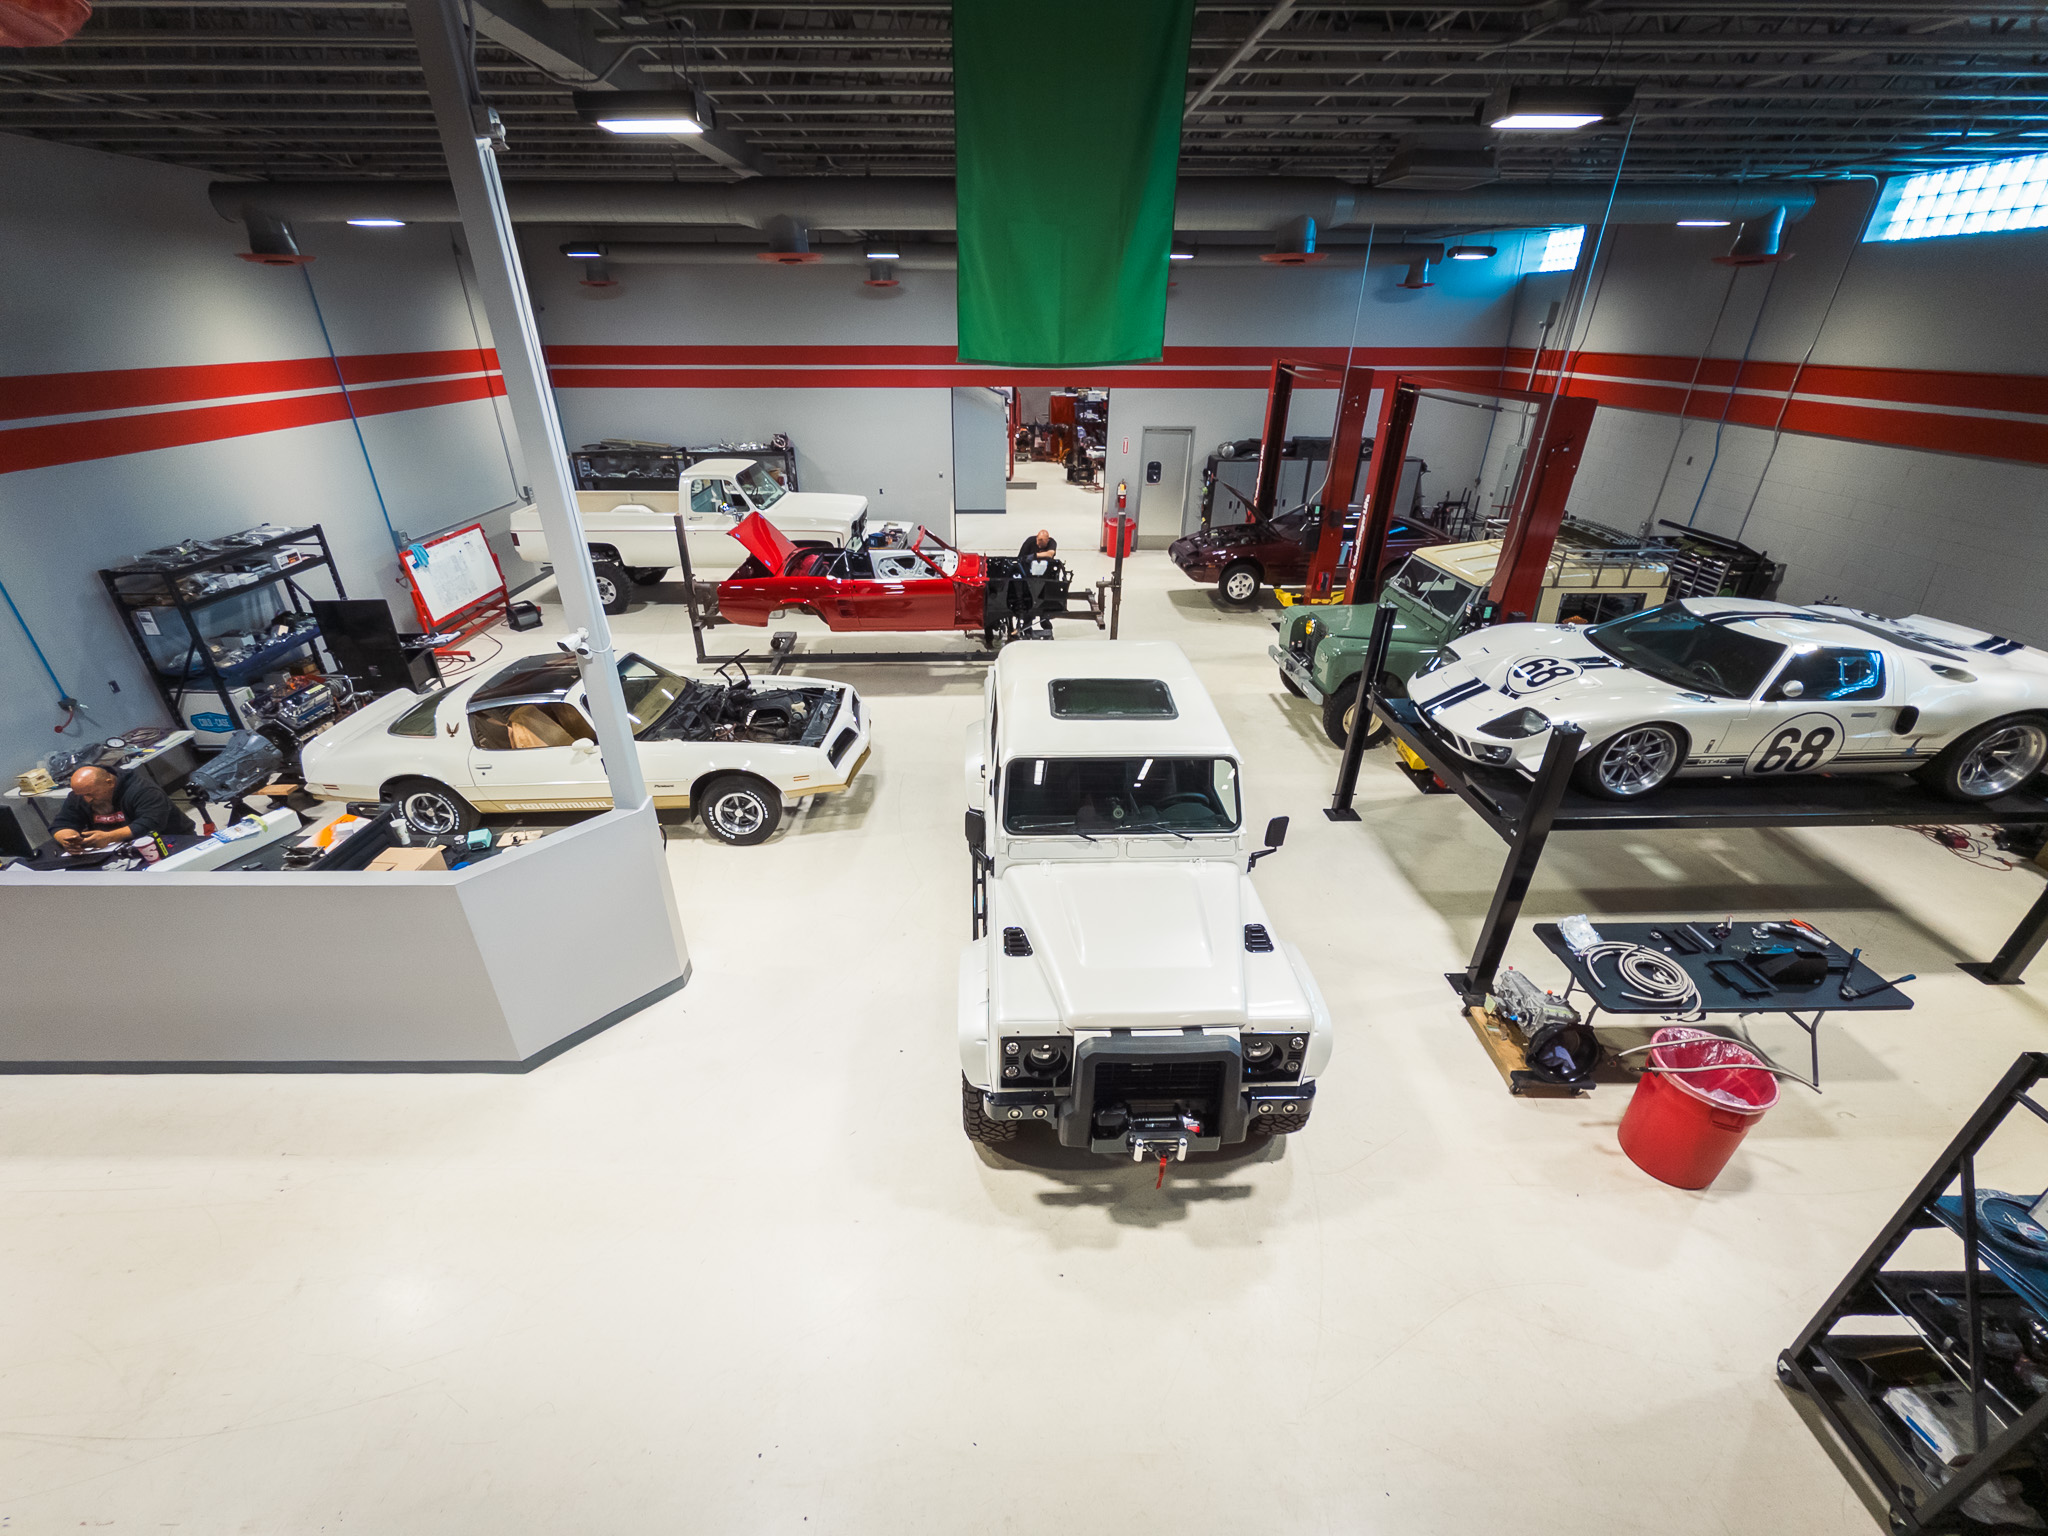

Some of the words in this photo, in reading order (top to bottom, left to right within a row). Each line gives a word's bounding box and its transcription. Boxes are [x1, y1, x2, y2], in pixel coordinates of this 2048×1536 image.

[1352, 514, 1366, 567] Challenger
[1362, 493, 1371, 515] Lifts
[1513, 658, 1574, 688] 68
[1752, 726, 1835, 773] 68
[504, 801, 615, 811] FORMUL
